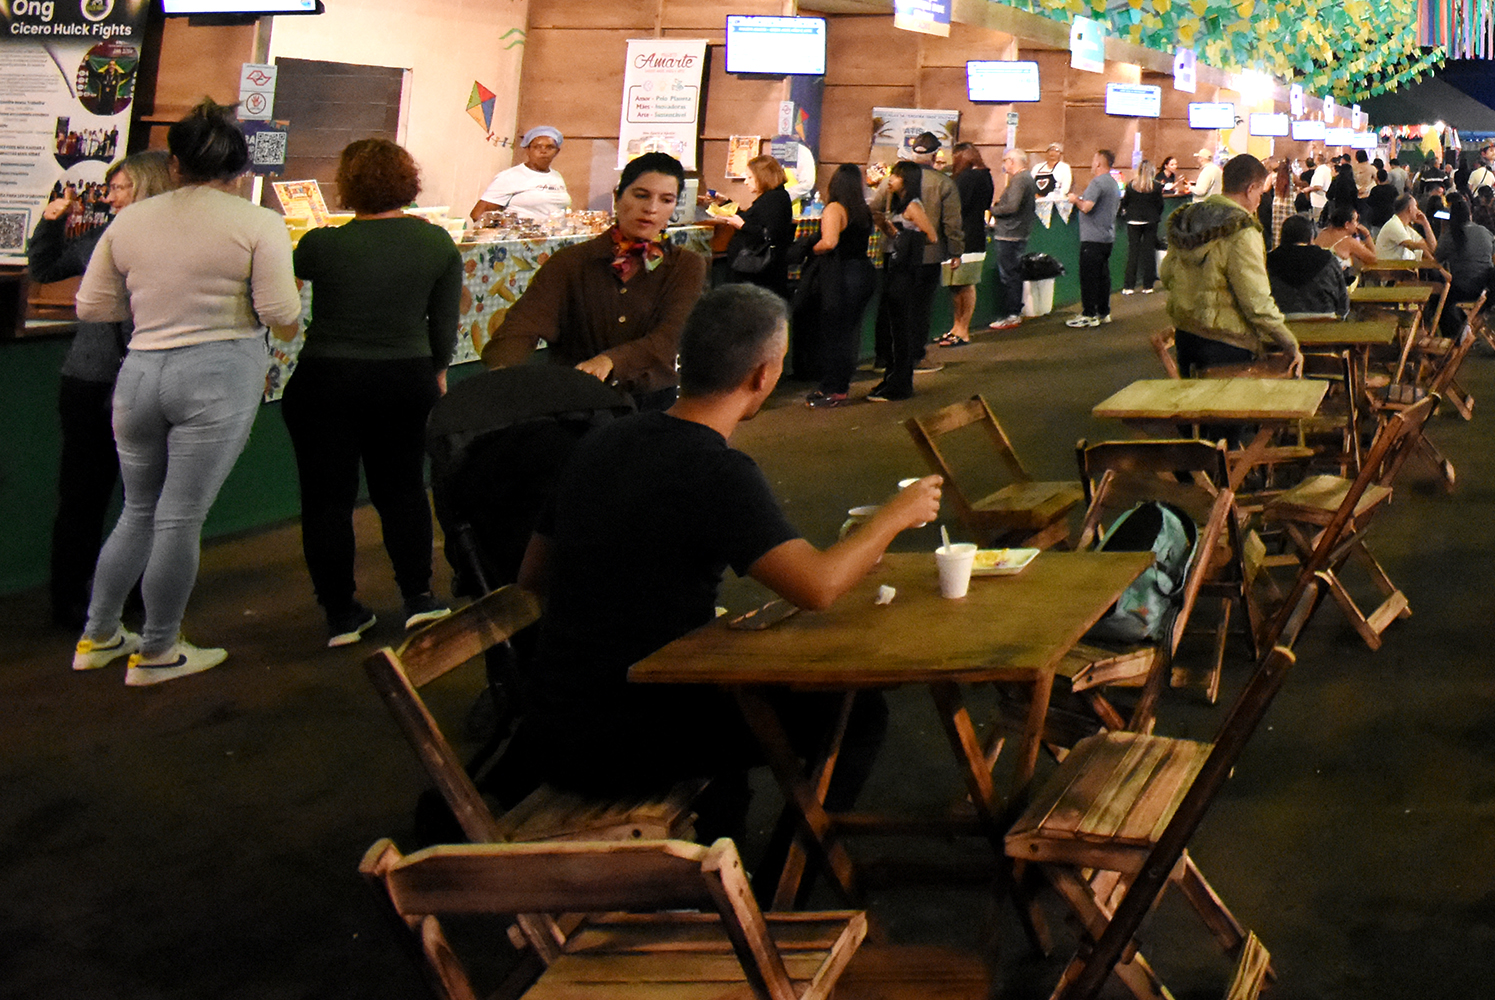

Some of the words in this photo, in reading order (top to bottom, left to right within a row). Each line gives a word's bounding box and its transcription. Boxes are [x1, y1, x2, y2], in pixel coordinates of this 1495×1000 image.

[11, 21, 52, 35] Cicero
[53, 22, 90, 36] Hulck
[92, 22, 132, 39] Fights
[634, 52, 698, 69] Amarte
